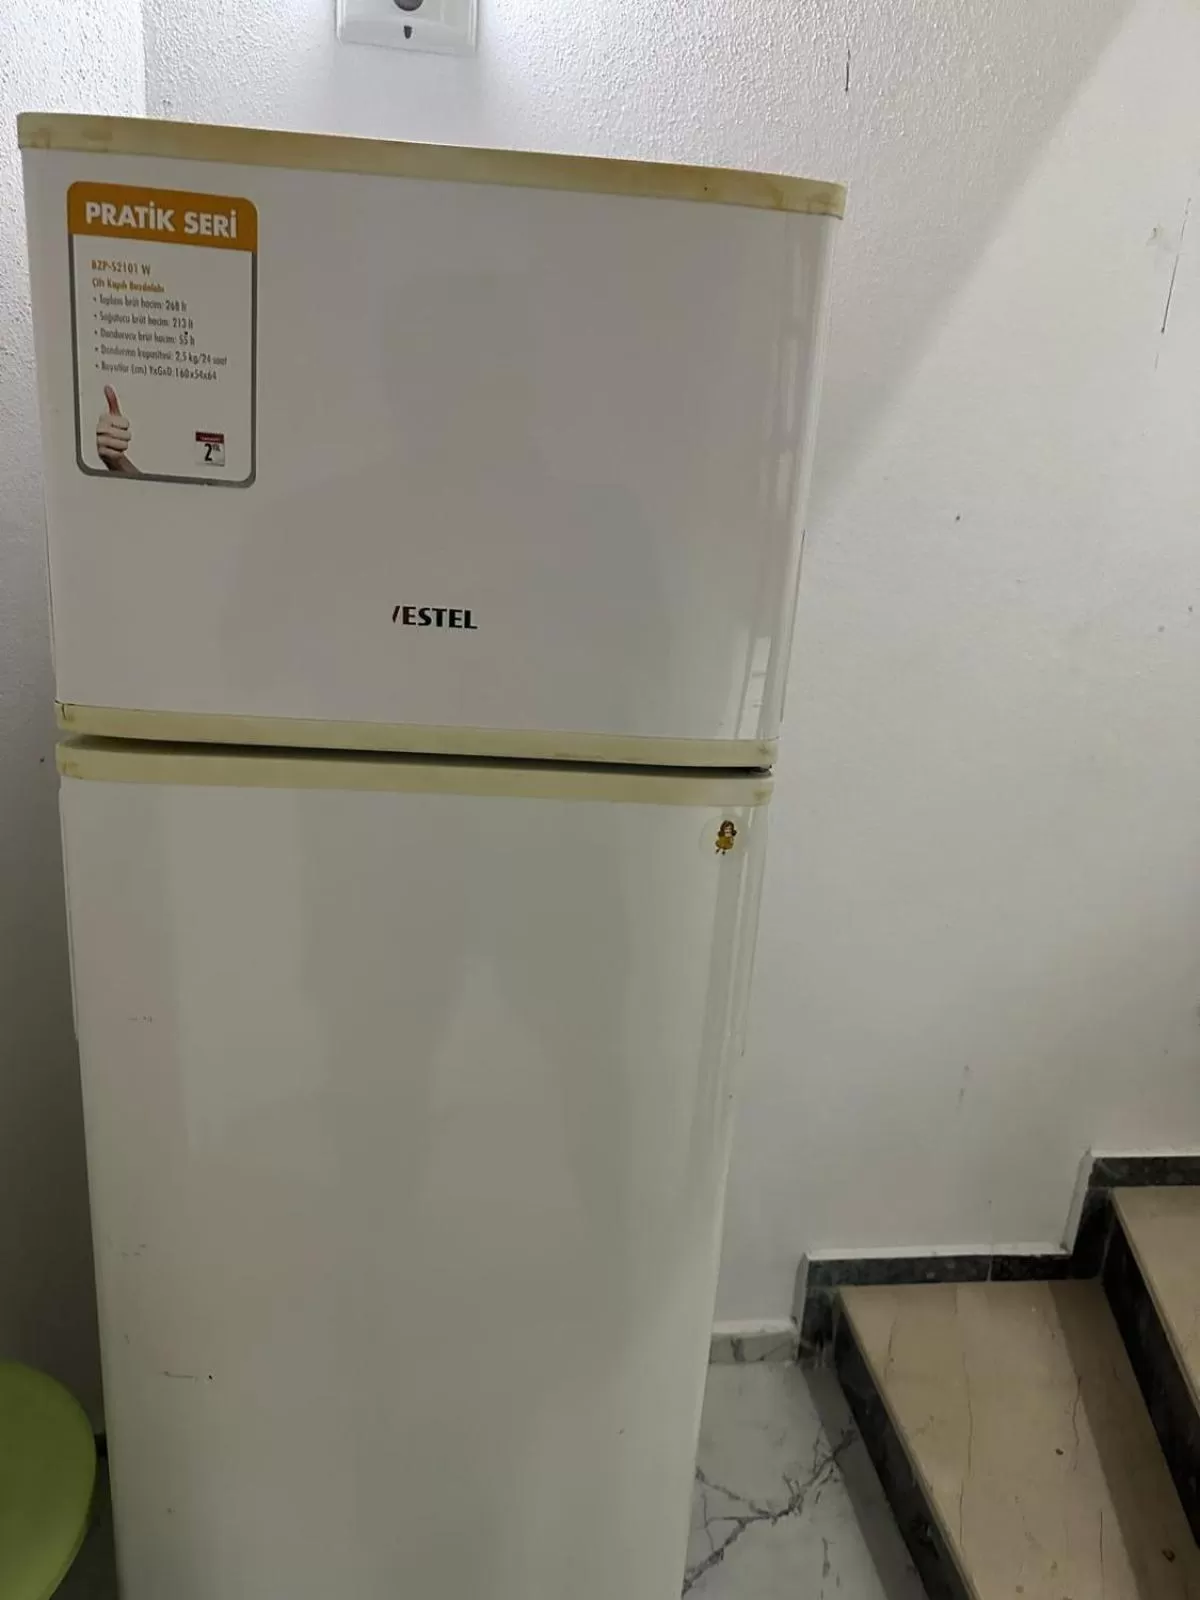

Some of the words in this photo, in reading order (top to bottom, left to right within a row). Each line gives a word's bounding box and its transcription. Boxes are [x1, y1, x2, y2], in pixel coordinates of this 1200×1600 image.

[86, 201, 175, 232] PRATİK
[184, 209, 237, 239] SERİ
[141, 264, 151, 276] W
[172, 317, 187, 328] 213
[204, 443, 213, 462] 2
